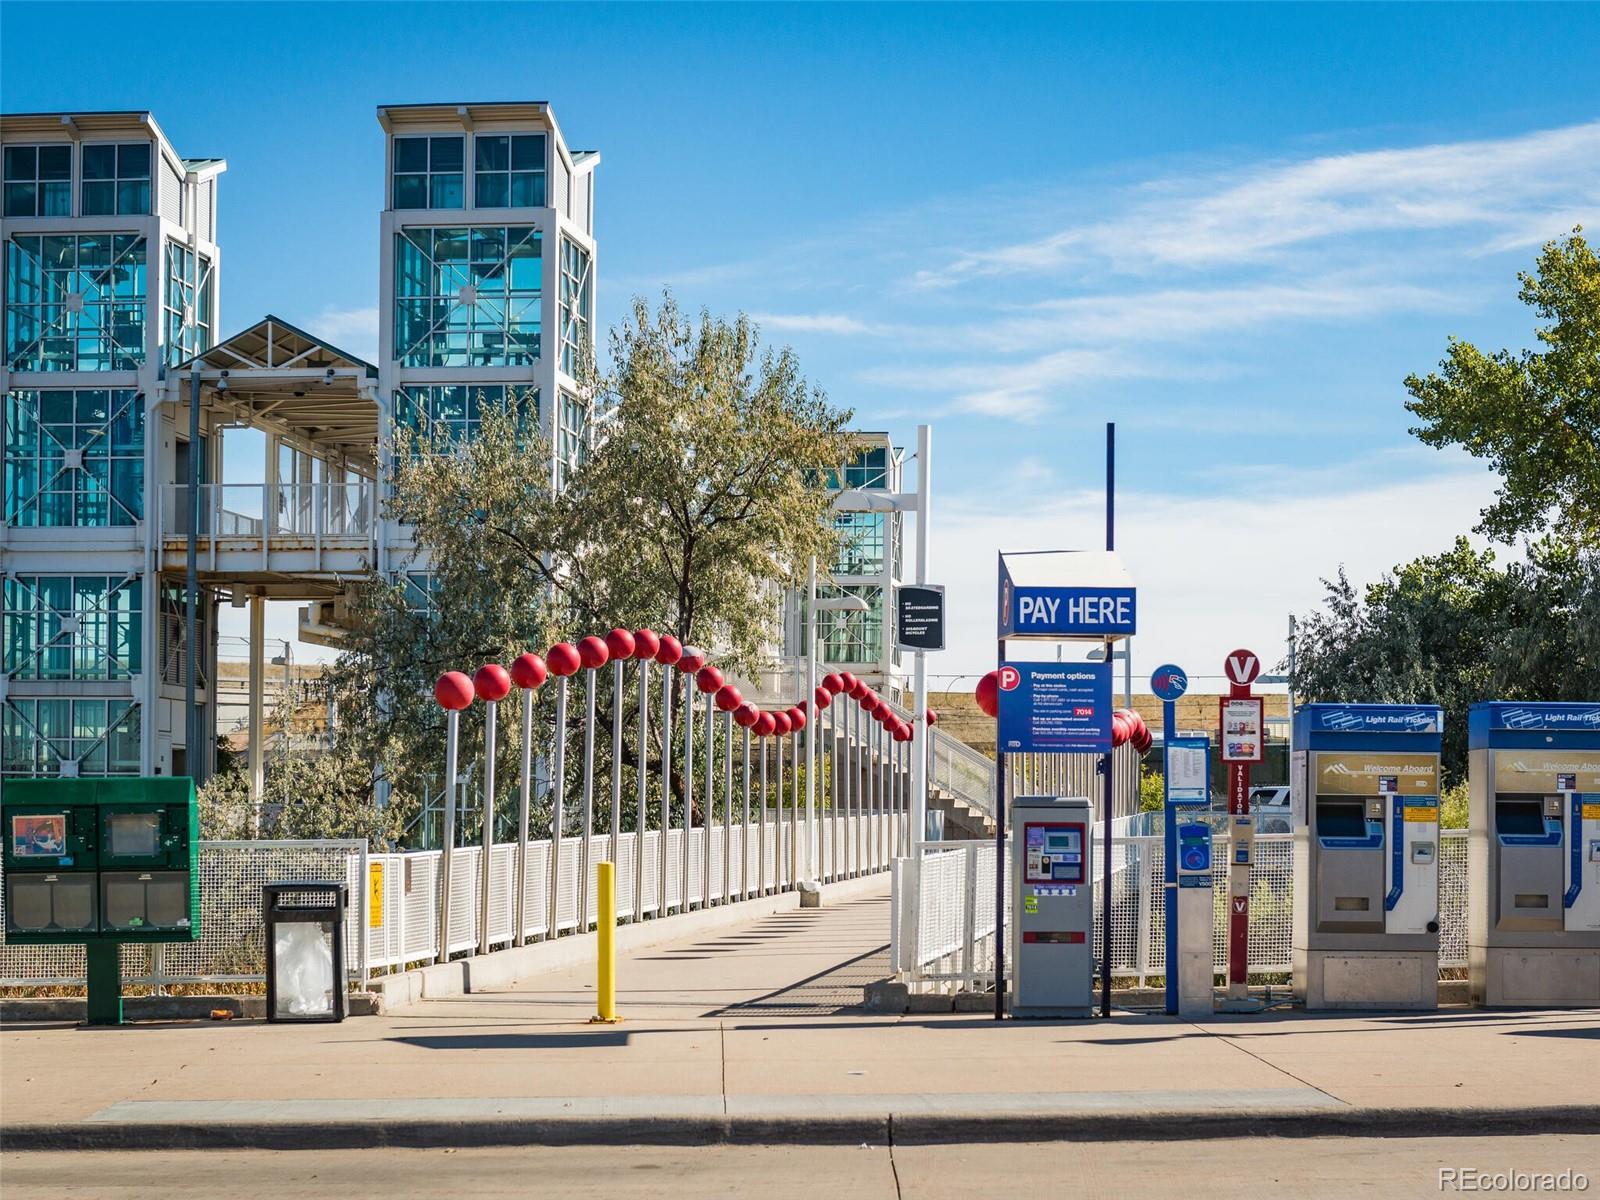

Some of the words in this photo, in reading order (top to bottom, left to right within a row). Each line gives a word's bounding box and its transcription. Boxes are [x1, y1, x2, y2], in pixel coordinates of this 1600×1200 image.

[1019, 596, 1060, 624] PAY
[1068, 596, 1131, 624] HERE
[1229, 656, 1256, 683] V
[1002, 670, 1016, 688] P
[1031, 671, 1066, 680] Payment
[1066, 671, 1096, 681] options
[1366, 716, 1386, 724] Light
[1545, 713, 1565, 722] Light
[1566, 713, 1583, 721] Rail
[1364, 763, 1401, 773] Welcome
[1542, 761, 1580, 771] Welcome
[1235, 902, 1245, 912] V
